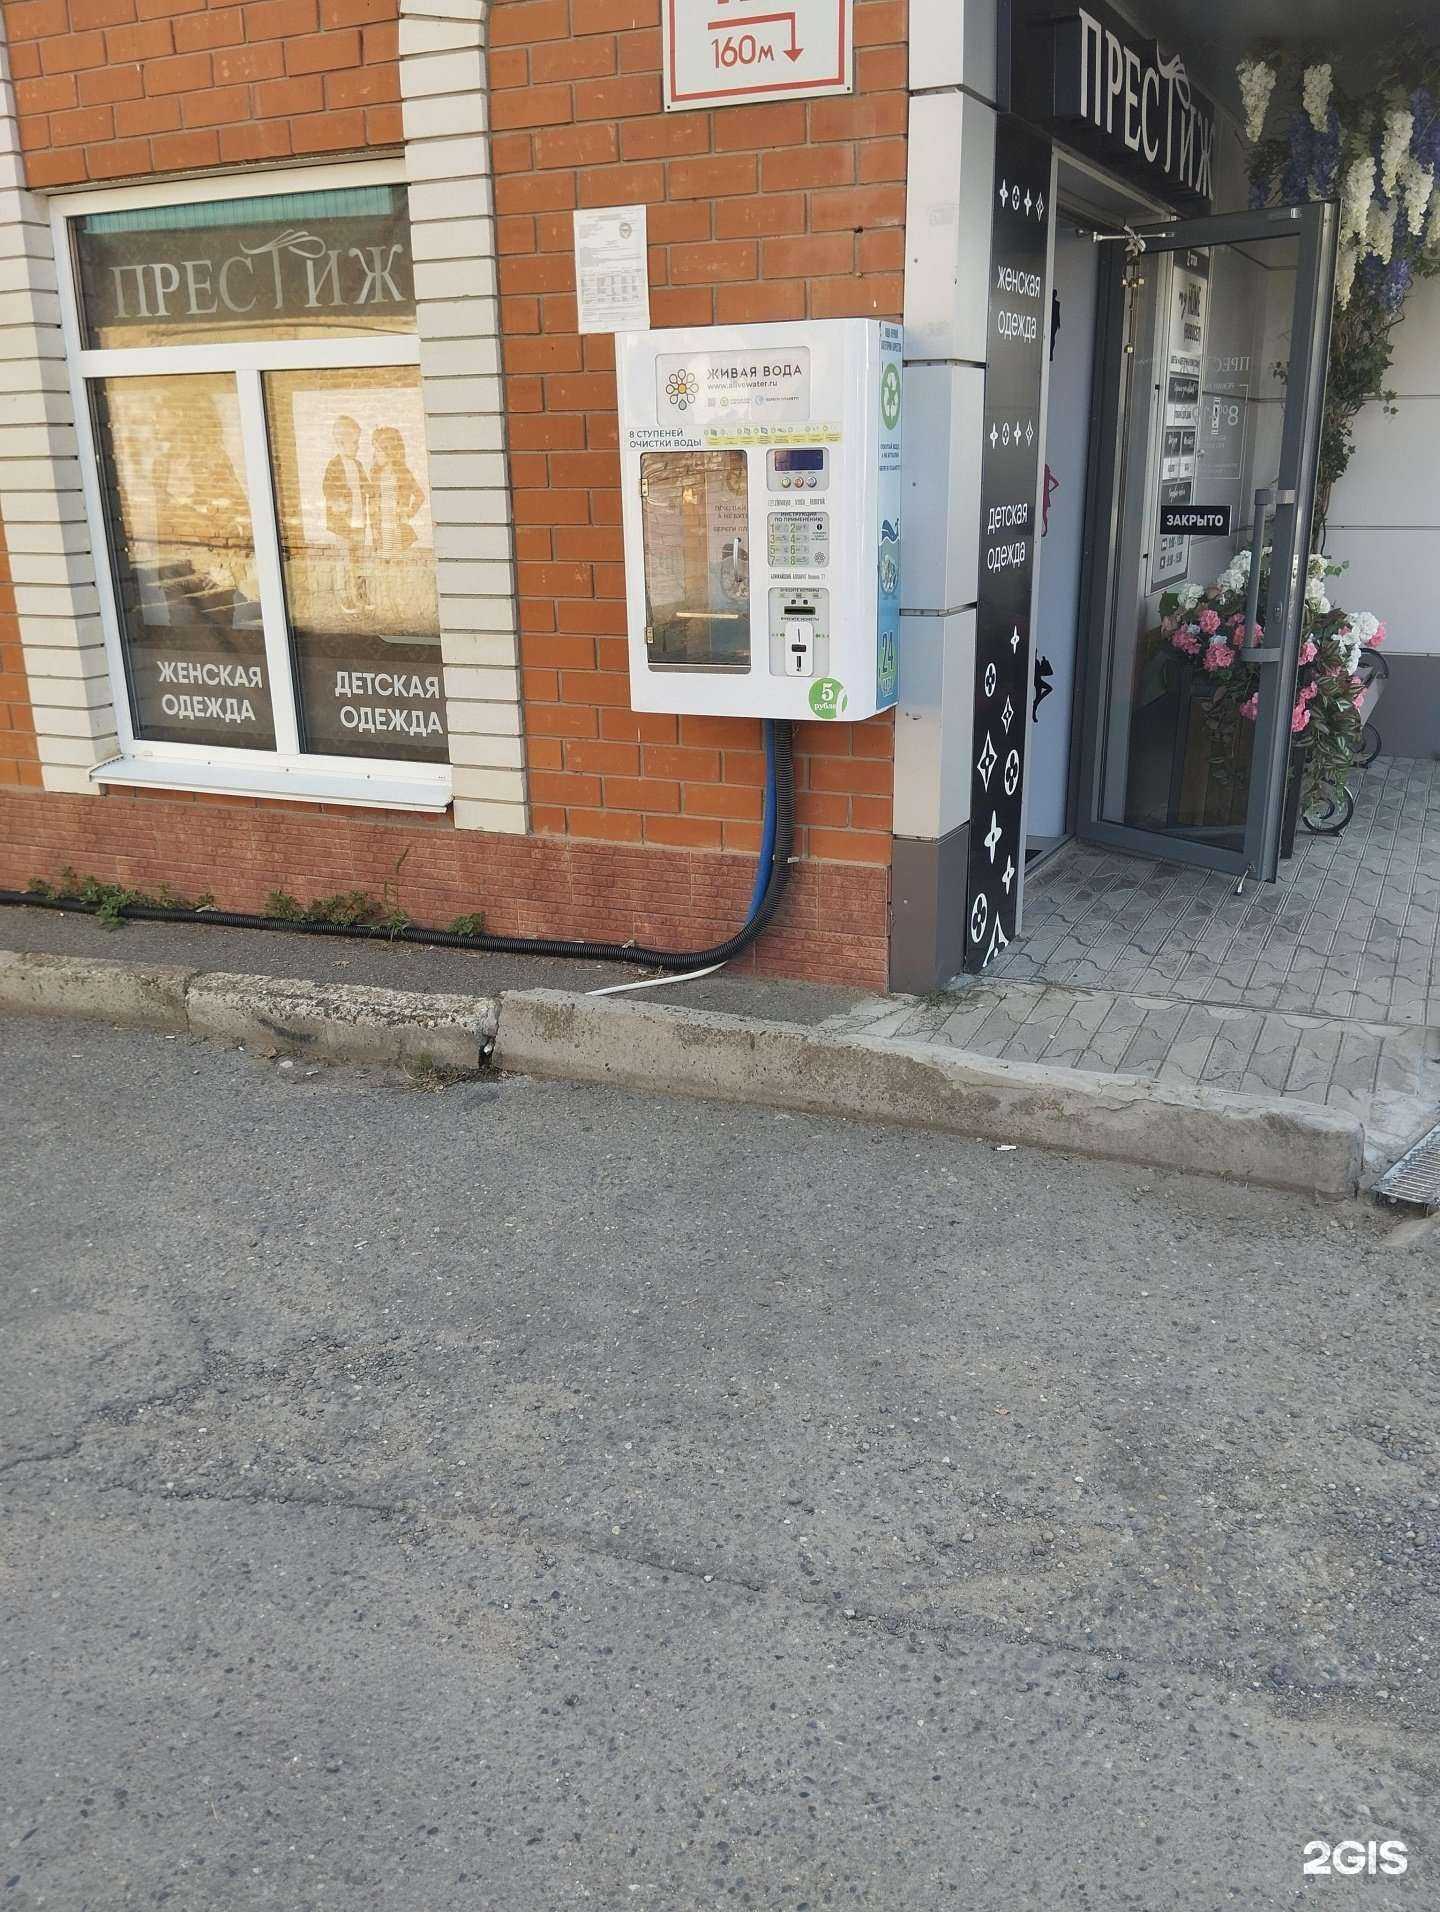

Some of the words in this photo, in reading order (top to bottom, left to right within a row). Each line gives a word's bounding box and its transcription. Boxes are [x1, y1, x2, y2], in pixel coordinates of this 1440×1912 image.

[1079, 7, 1215, 200] ПРЕСТИЖ
[109, 229, 407, 318] ПРЕСТИЖ
[997, 265, 1041, 298] женская
[998, 310, 1037, 344] одежда
[707, 366, 757, 380] ЖИВАЯ
[763, 364, 802, 378] ВОДА
[629, 440, 672, 448] ОЧИСТКИ
[674, 439, 702, 448] ВОДЫ
[636, 428, 683, 438] СТУПЕНЕЙ
[987, 503, 1028, 535] детская
[1166, 514, 1224, 527] ЗАКРЫТО
[987, 541, 1026, 573] одежда
[156, 660, 263, 688] ЖЕНСКАЯ
[335, 671, 440, 698] ДЕТСКАЯ
[821, 682, 834, 701] 5
[162, 694, 256, 723] ОДЕЖДА
[340, 706, 444, 737] ОДЕЖДА
